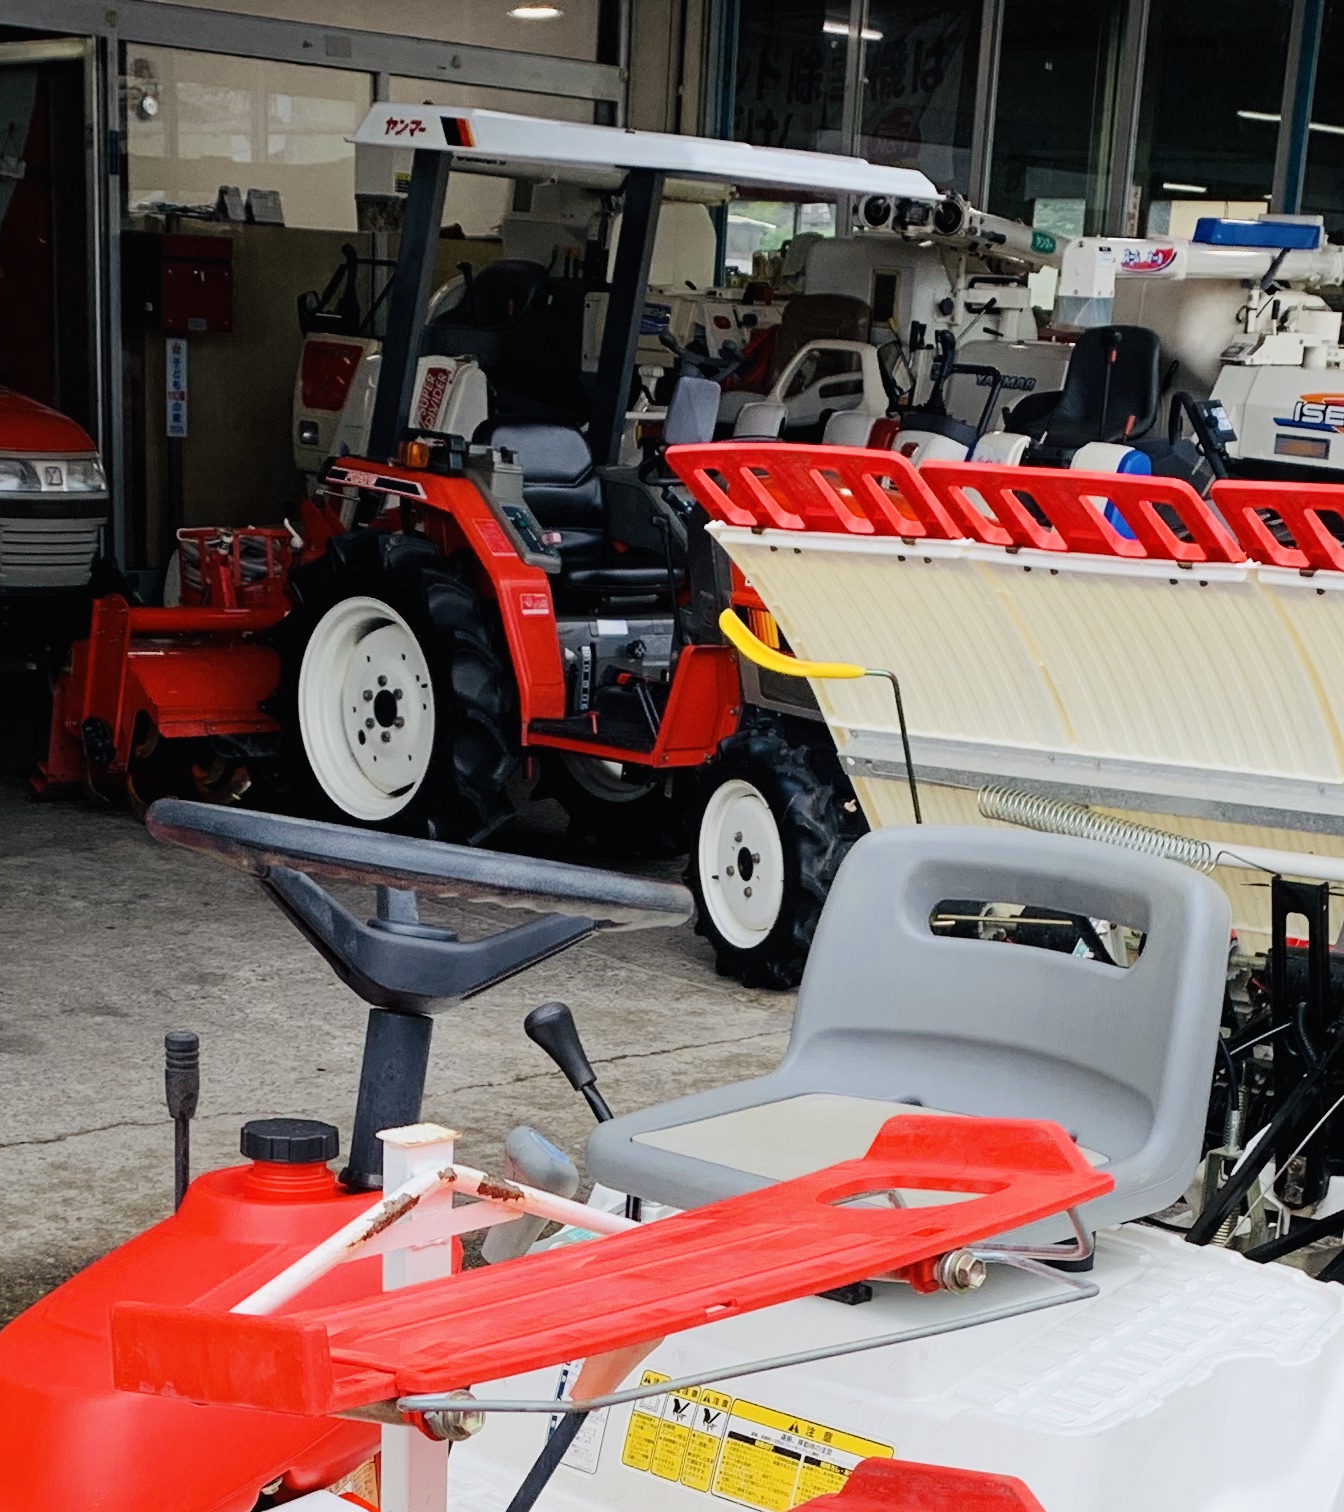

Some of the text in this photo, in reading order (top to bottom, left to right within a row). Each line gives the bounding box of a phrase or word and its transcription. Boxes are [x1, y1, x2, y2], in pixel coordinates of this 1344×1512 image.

[385, 117, 426, 137] ヤンマー
[419, 373, 437, 417] SUPER
[423, 371, 448, 429] DIVIDER
[805, 1425, 834, 1444] 注意
